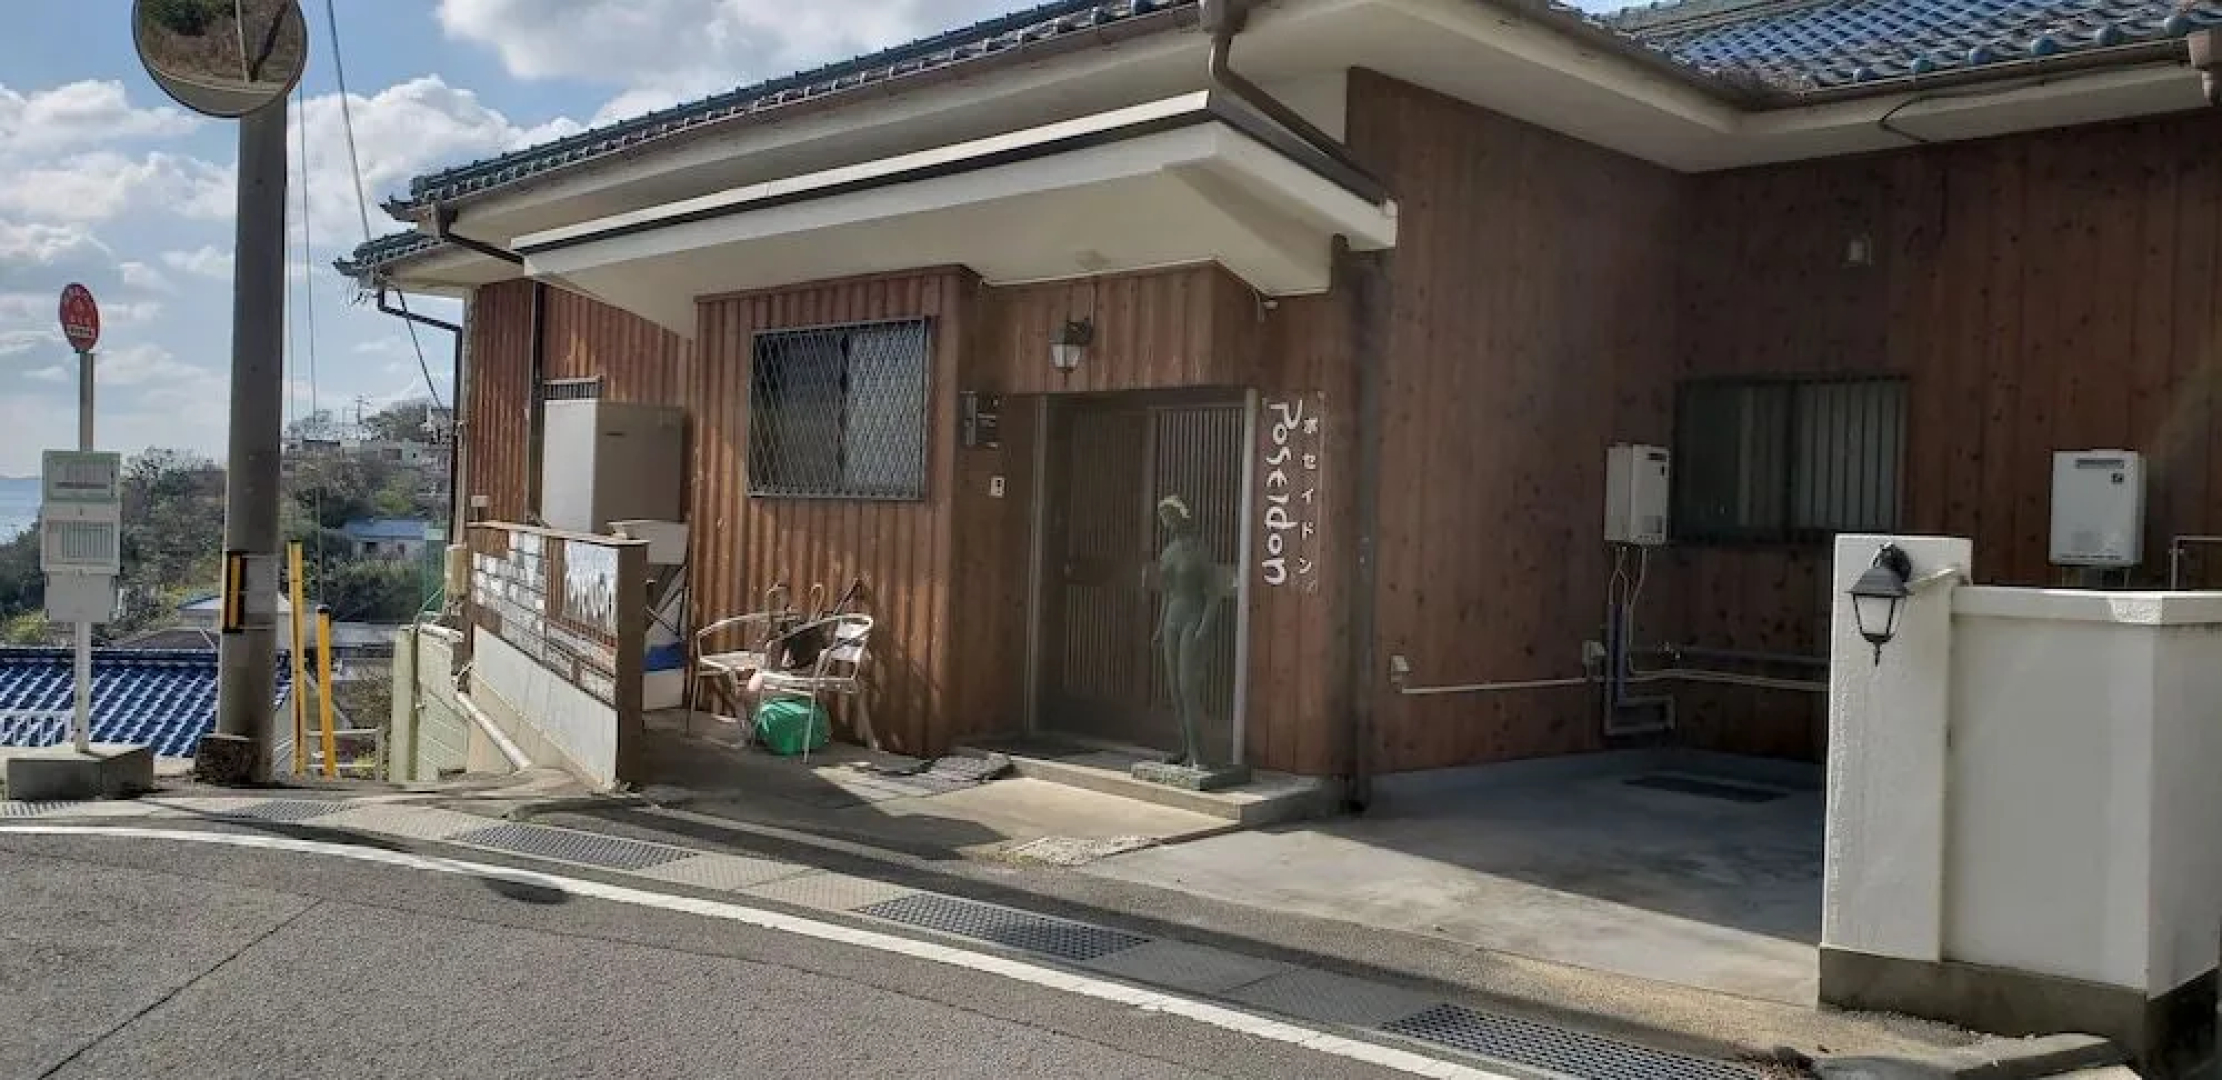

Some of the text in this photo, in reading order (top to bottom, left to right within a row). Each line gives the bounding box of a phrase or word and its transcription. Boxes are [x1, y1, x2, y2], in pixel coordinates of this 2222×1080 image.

[1299, 416, 1319, 573] ポセイドン
